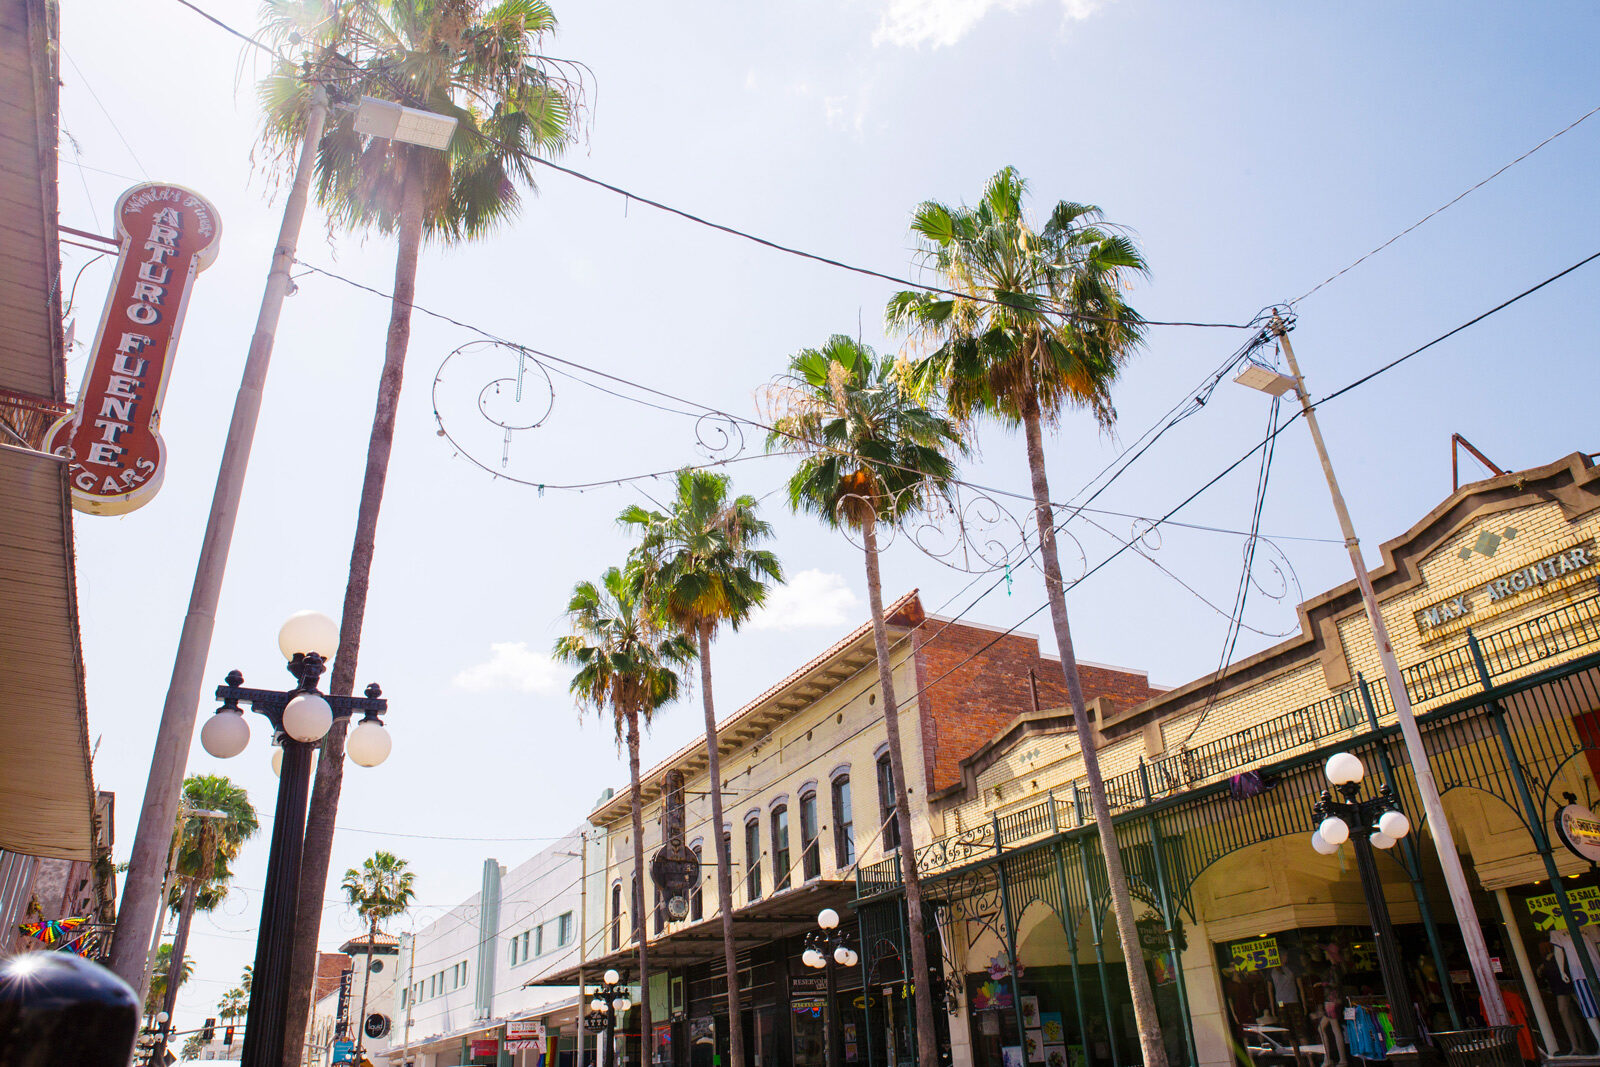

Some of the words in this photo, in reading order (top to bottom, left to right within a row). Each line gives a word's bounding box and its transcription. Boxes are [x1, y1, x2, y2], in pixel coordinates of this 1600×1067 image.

[126, 207, 181, 325] ARTURO
[87, 332, 152, 467] FUENTE
[1423, 595, 1468, 629] MAX
[1486, 547, 1589, 602] ARGINTAR
[1542, 895, 1558, 906] SAL
